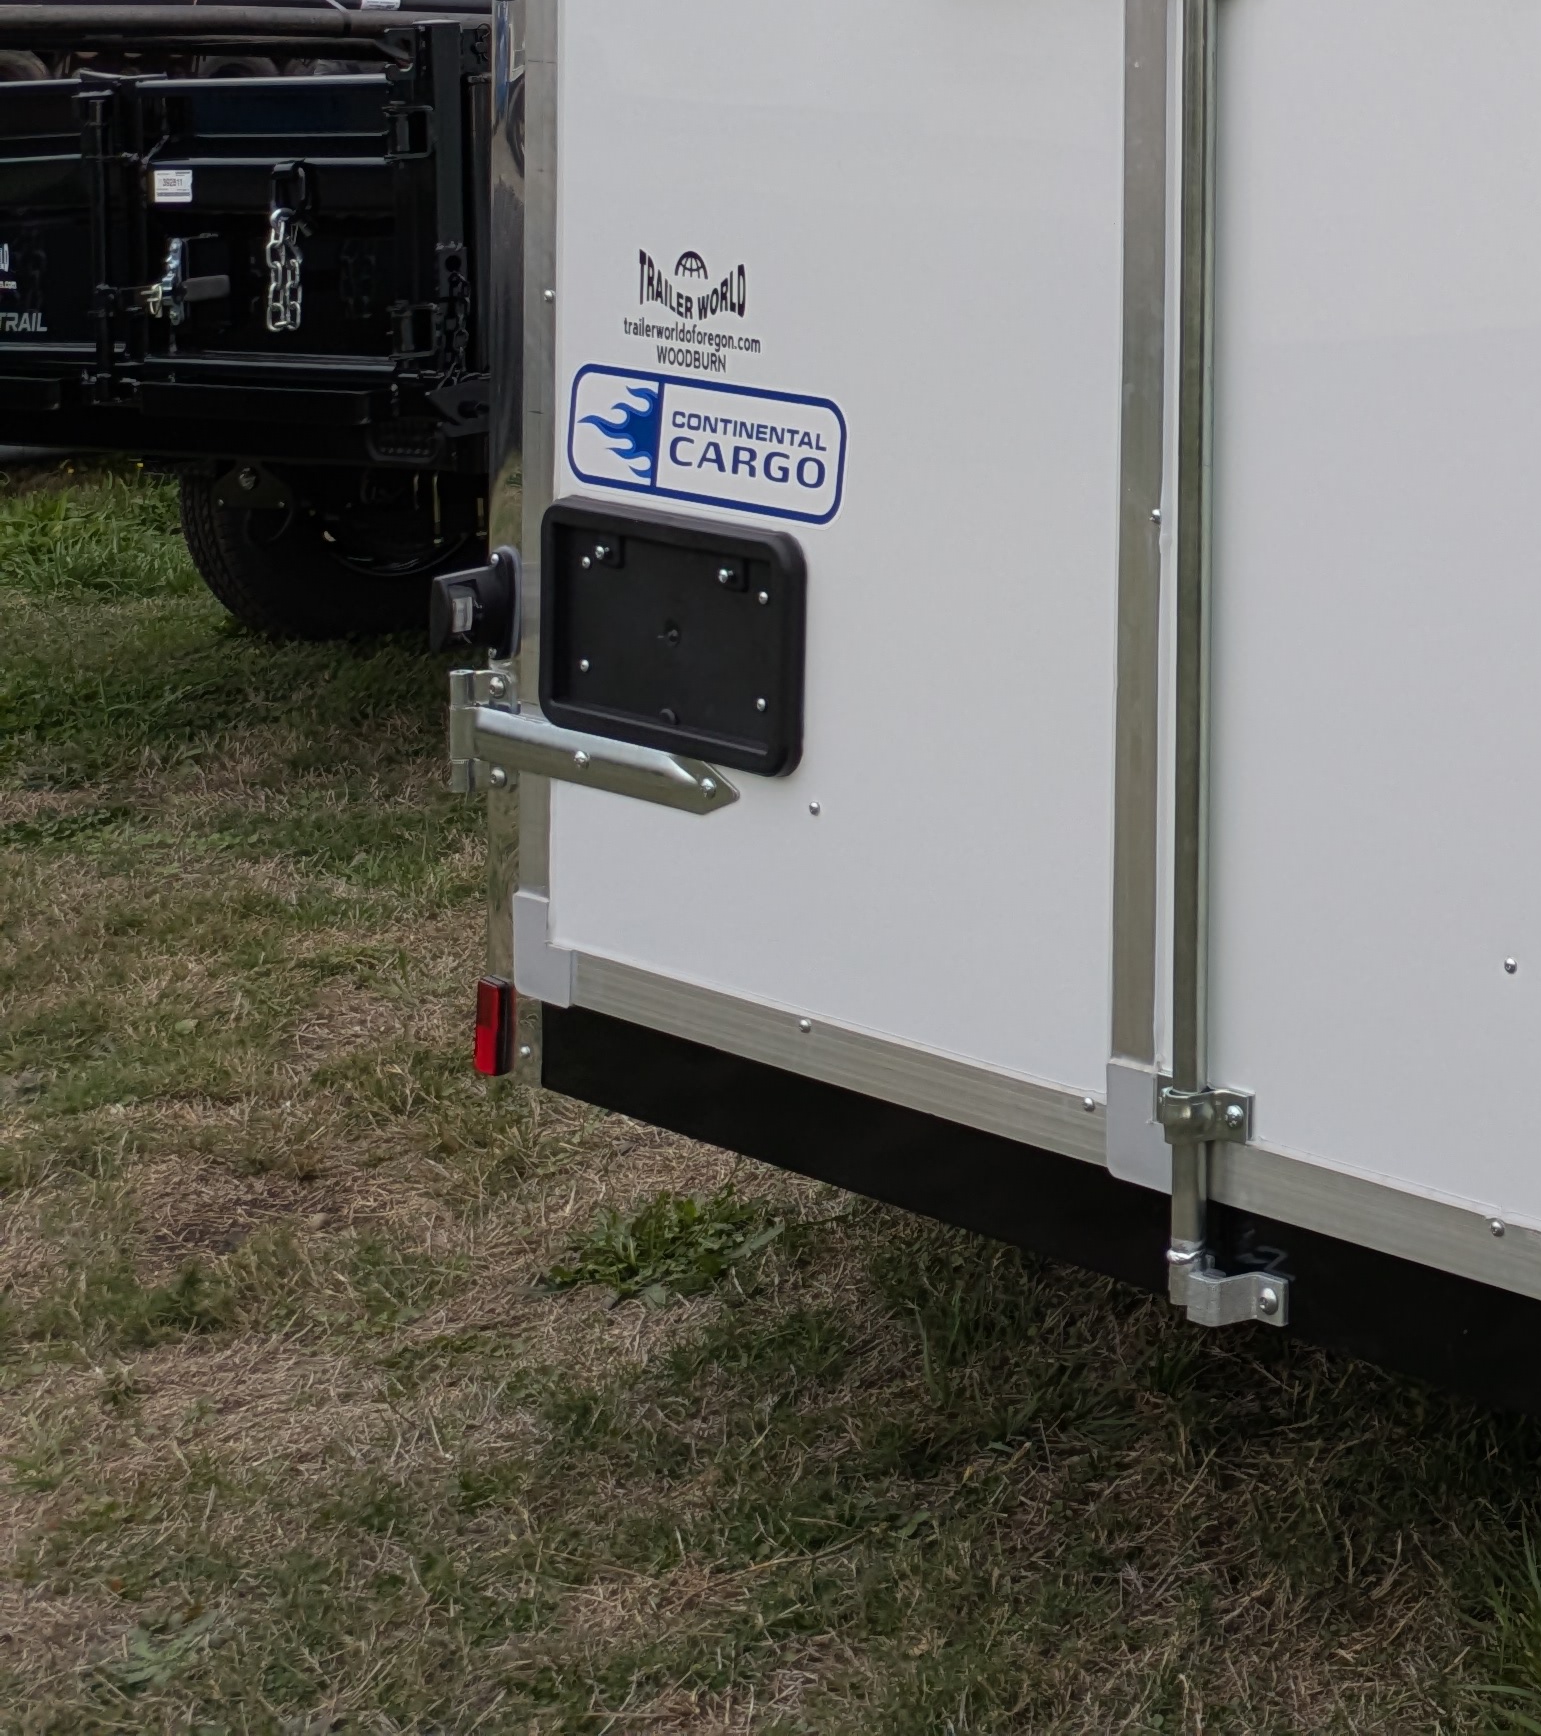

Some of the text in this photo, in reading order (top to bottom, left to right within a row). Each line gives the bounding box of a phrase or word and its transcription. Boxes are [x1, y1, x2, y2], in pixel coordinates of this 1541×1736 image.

[639, 248, 746, 321] TRAILER WORLD
[623, 316, 762, 354] trailerworldoforegon.com
[656, 344, 727, 374] WOODBURN
[671, 410, 828, 452] CONTINENTAL
[668, 435, 826, 489] CARGO
